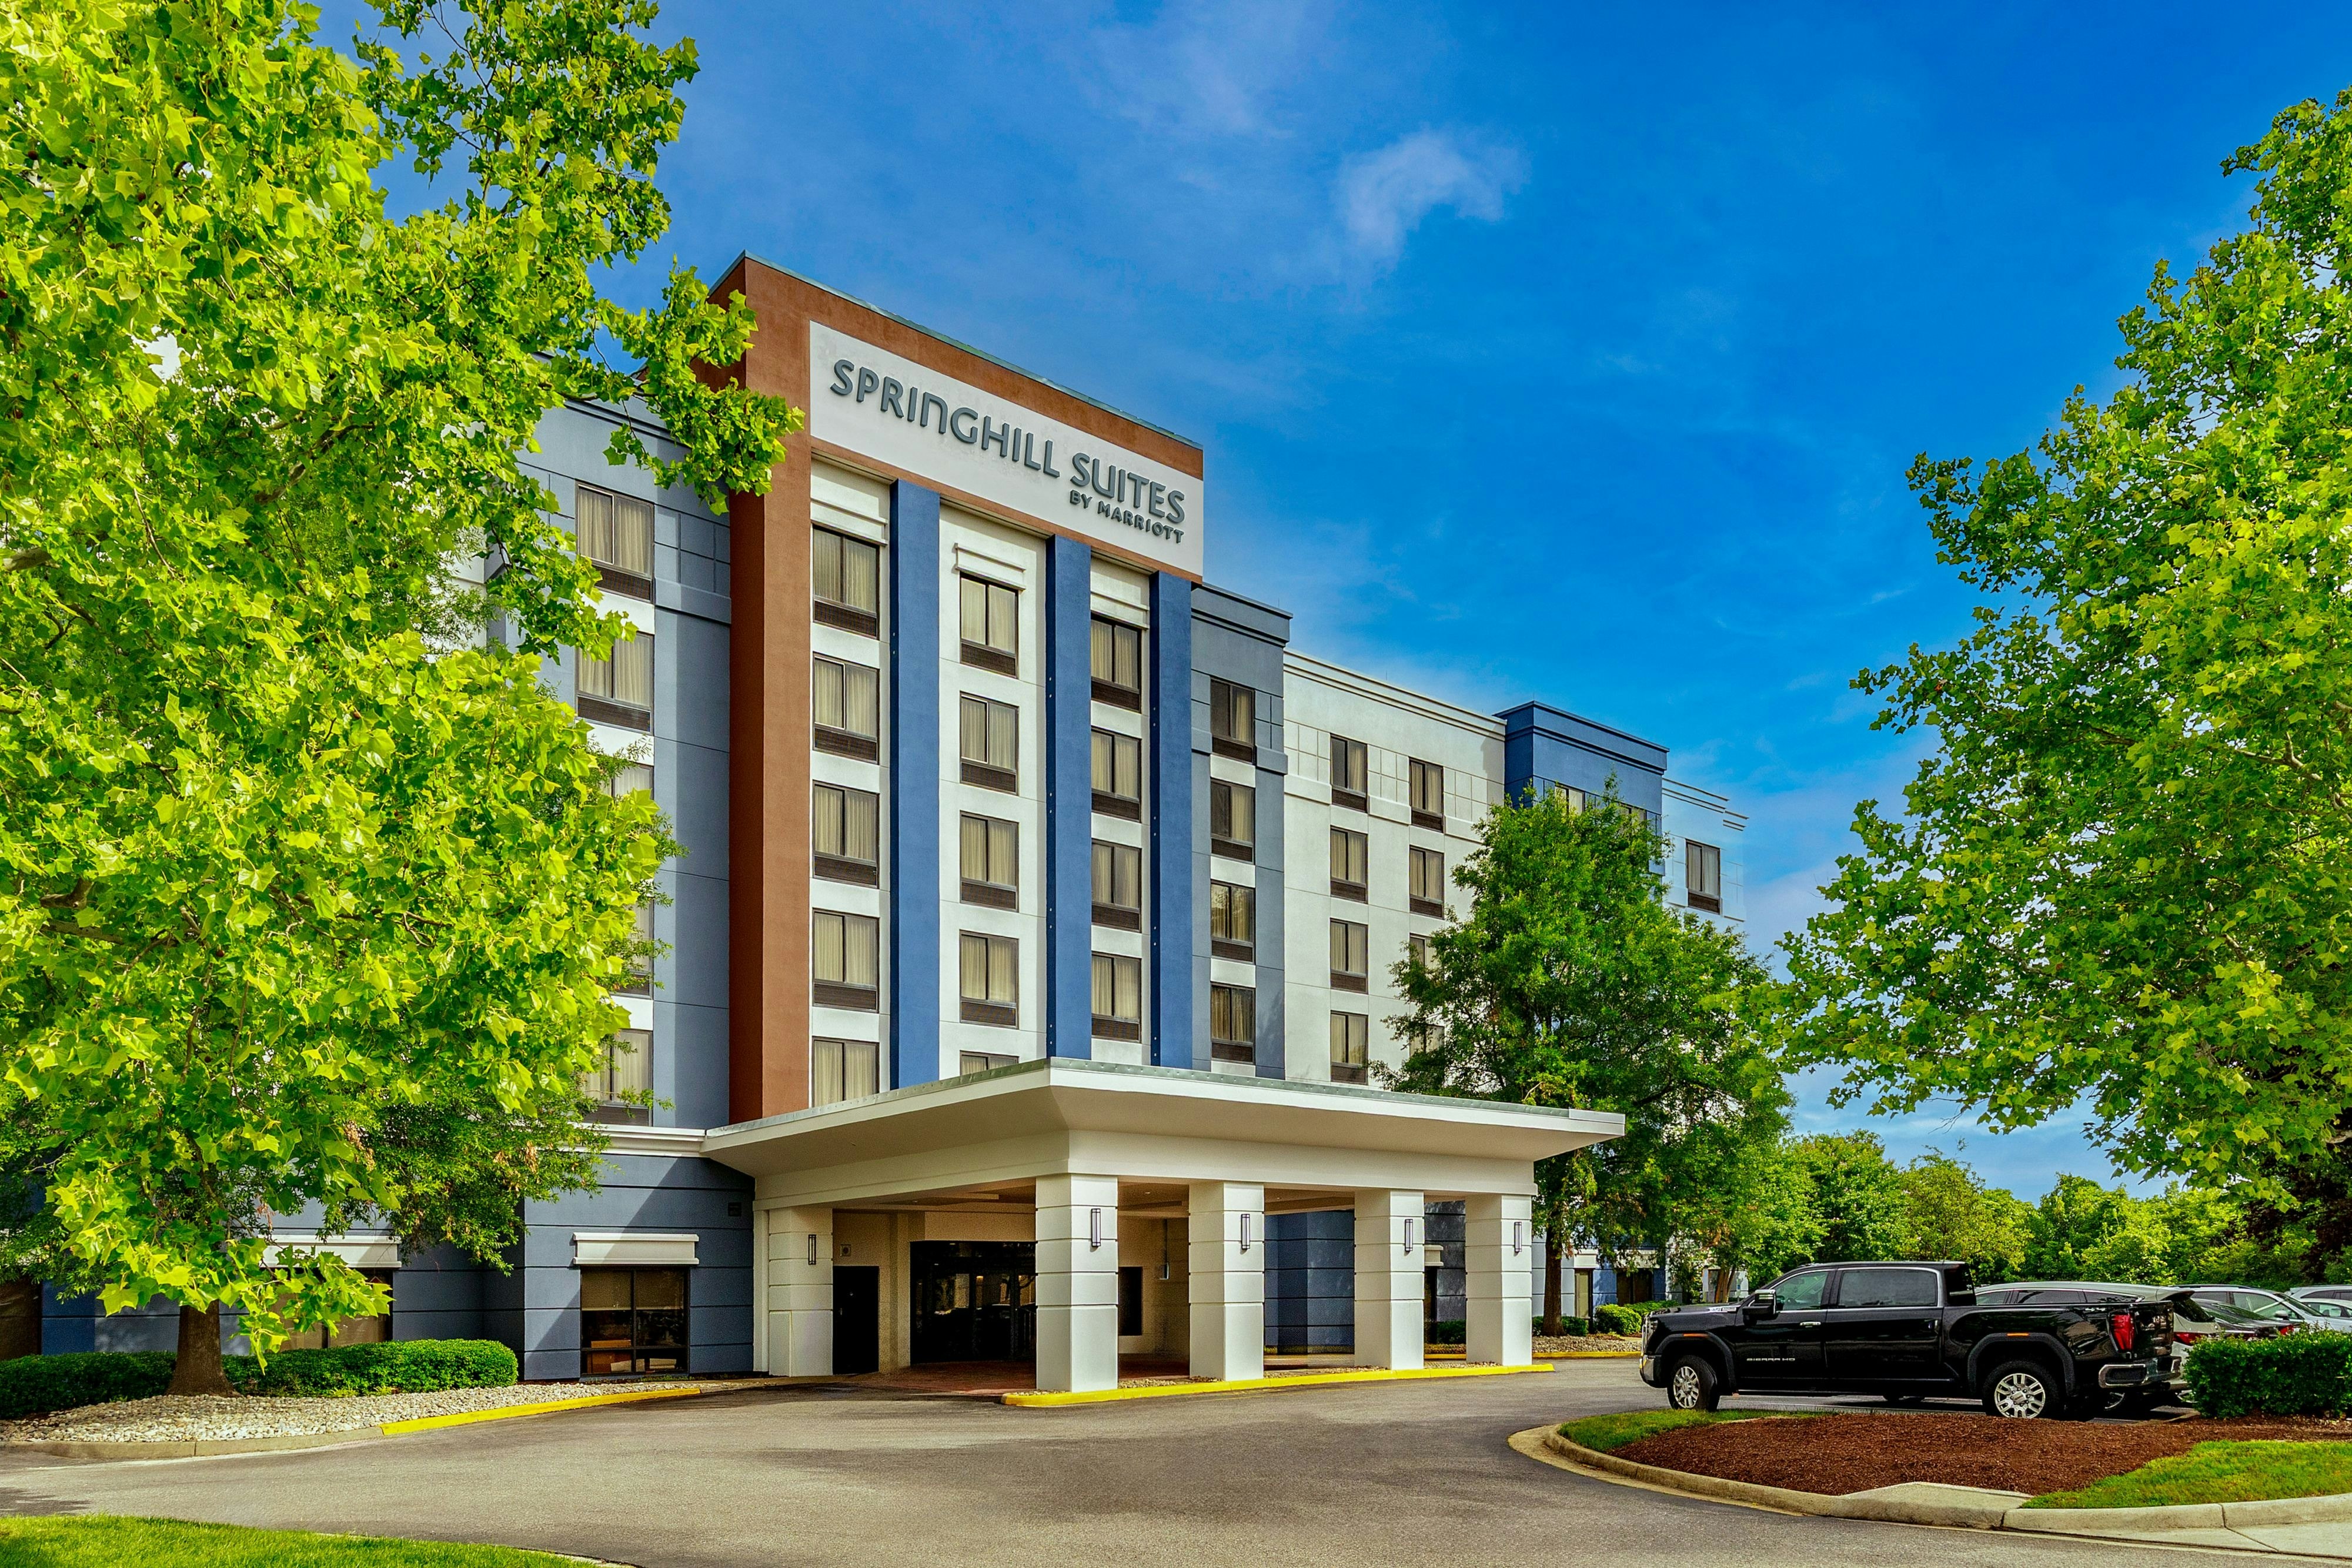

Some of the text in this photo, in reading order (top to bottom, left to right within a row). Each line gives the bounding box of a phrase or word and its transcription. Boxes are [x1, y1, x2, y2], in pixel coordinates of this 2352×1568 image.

[830, 359, 1185, 524] SPRINGHILL SUITES
[1070, 490, 1184, 543] BY MARRIOTT
